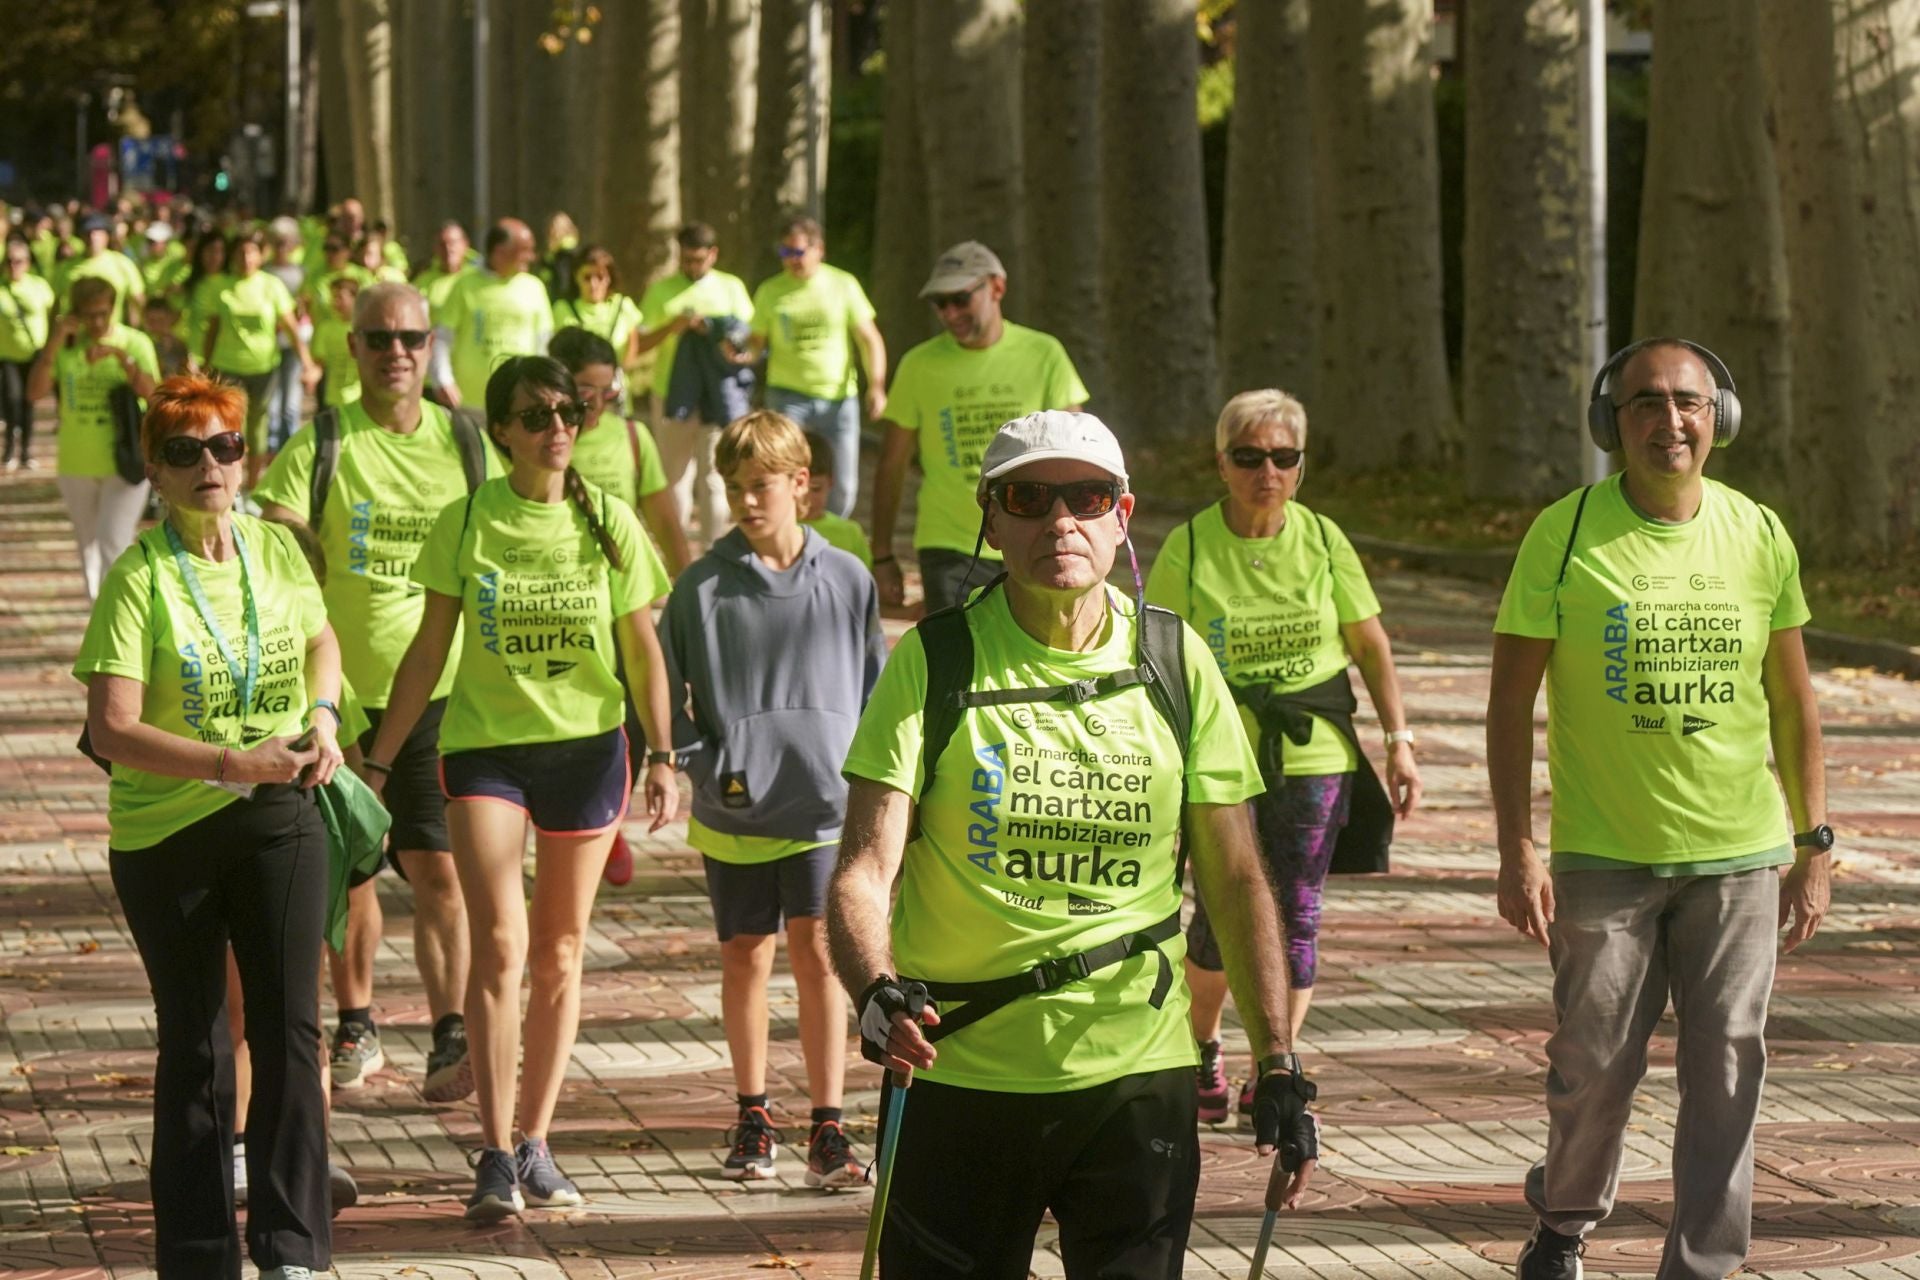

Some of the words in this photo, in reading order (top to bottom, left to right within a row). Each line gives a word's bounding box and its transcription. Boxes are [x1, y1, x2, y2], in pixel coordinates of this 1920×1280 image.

[375, 512, 391, 526] el
[349, 499, 372, 576] ARABA
[504, 582, 521, 594] el
[478, 570, 500, 656] ARABA
[503, 594, 597, 612] martxan
[1635, 601, 1651, 611] En
[1654, 601, 1701, 611] marcha
[1704, 602, 1740, 612] contra
[503, 613, 597, 627] minbiziaren
[1635, 613, 1657, 632] el
[1665, 612, 1742, 632] cáncer
[505, 627, 596, 655] aurka
[1230, 624, 1249, 639] el
[1232, 635, 1322, 654] martxan
[1604, 602, 1629, 705] ARABA
[1635, 633, 1742, 654] martxan
[1634, 656, 1739, 672] minbiziaren
[178, 642, 204, 730] ARABA
[1634, 674, 1734, 705] aurka
[1631, 714, 1666, 729] Vital
[1014, 743, 1033, 757] En
[1038, 748, 1098, 764] marcha
[1103, 753, 1152, 766] contra
[1012, 760, 1041, 785] el
[1050, 764, 1152, 793] cáncer
[967, 742, 1007, 875] ARABA
[1010, 791, 1151, 823] martxan
[1006, 819, 1152, 847] minbiziaren
[1005, 846, 1141, 888] aurka
[1001, 889, 1045, 911] Vital
